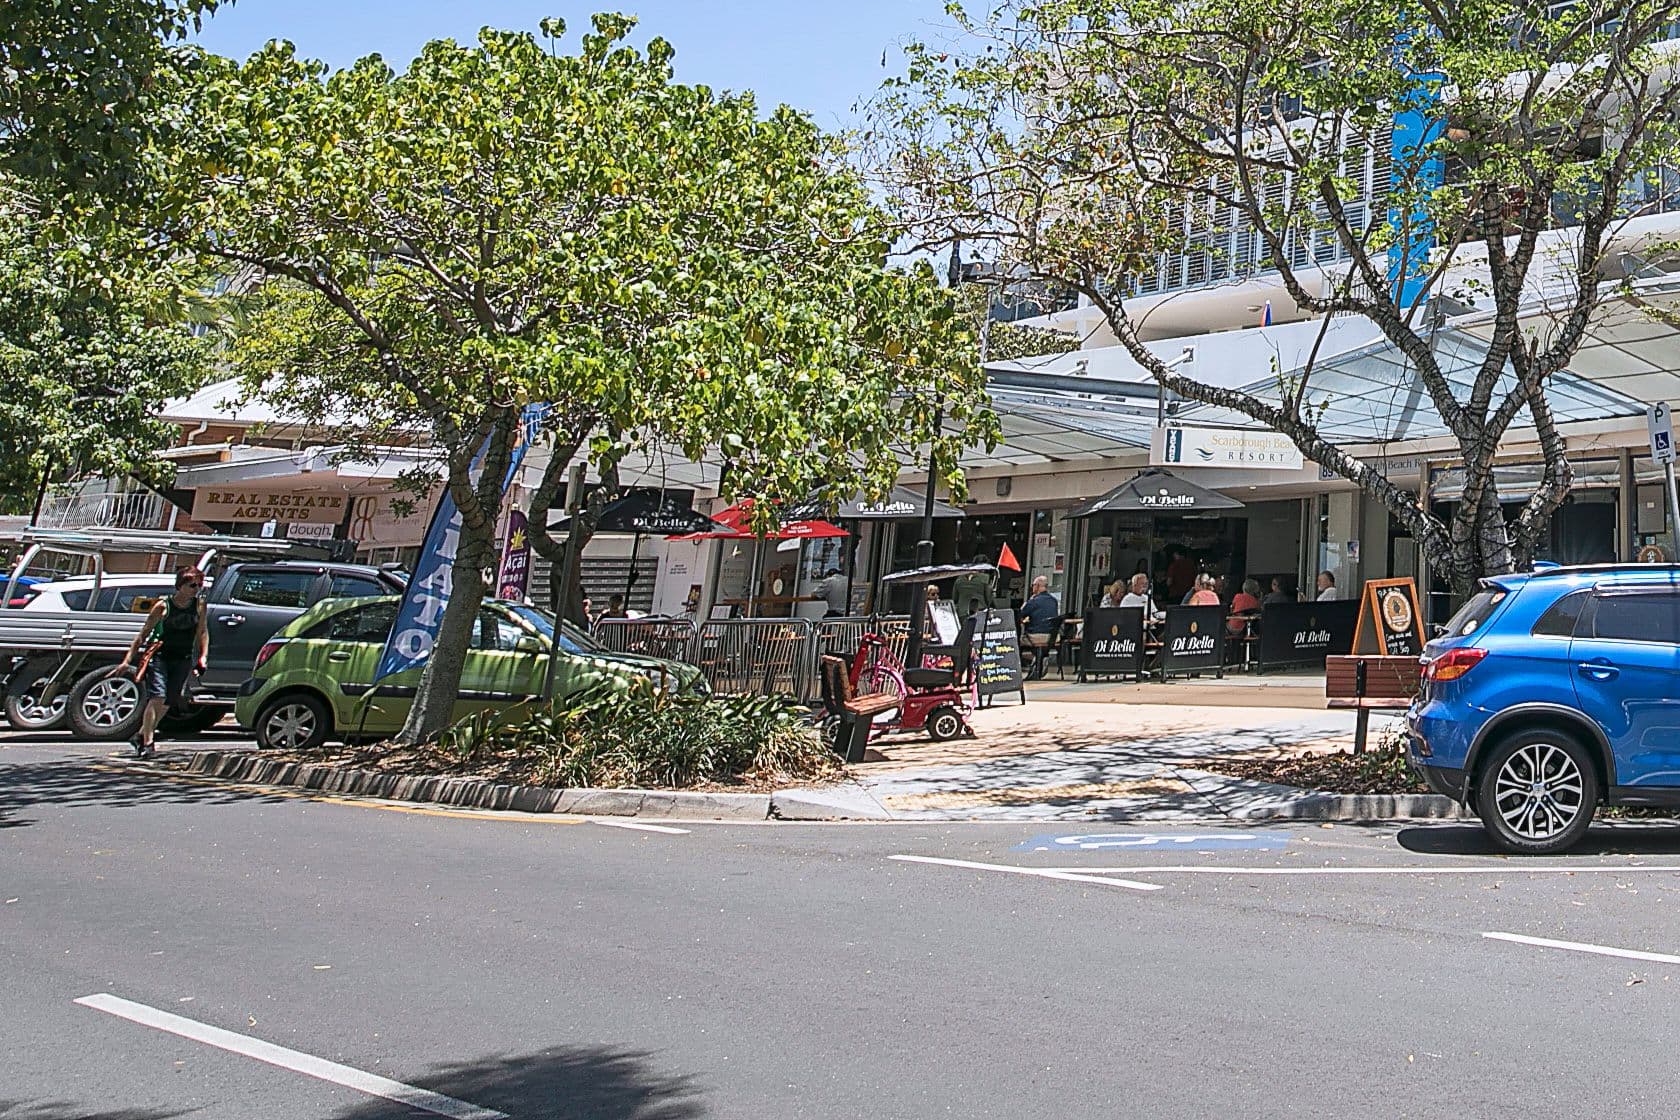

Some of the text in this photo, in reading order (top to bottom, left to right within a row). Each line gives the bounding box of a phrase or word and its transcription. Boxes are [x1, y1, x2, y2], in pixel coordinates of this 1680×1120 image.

[1654, 407, 1664, 423] P
[1211, 434, 1272, 449] Scarborough
[1228, 451, 1285, 462] RESORT
[1322, 467, 1334, 478] 89
[1388, 458, 1413, 470] Beach
[207, 492, 342, 508] REAL ESTATE
[1159, 494, 1195, 505] Bella
[232, 506, 310, 520] AGENTS
[289, 524, 332, 538] dough.
[1187, 635, 1215, 650] Bella
[1307, 629, 1331, 643] Bella
[1109, 638, 1136, 653] Bella
